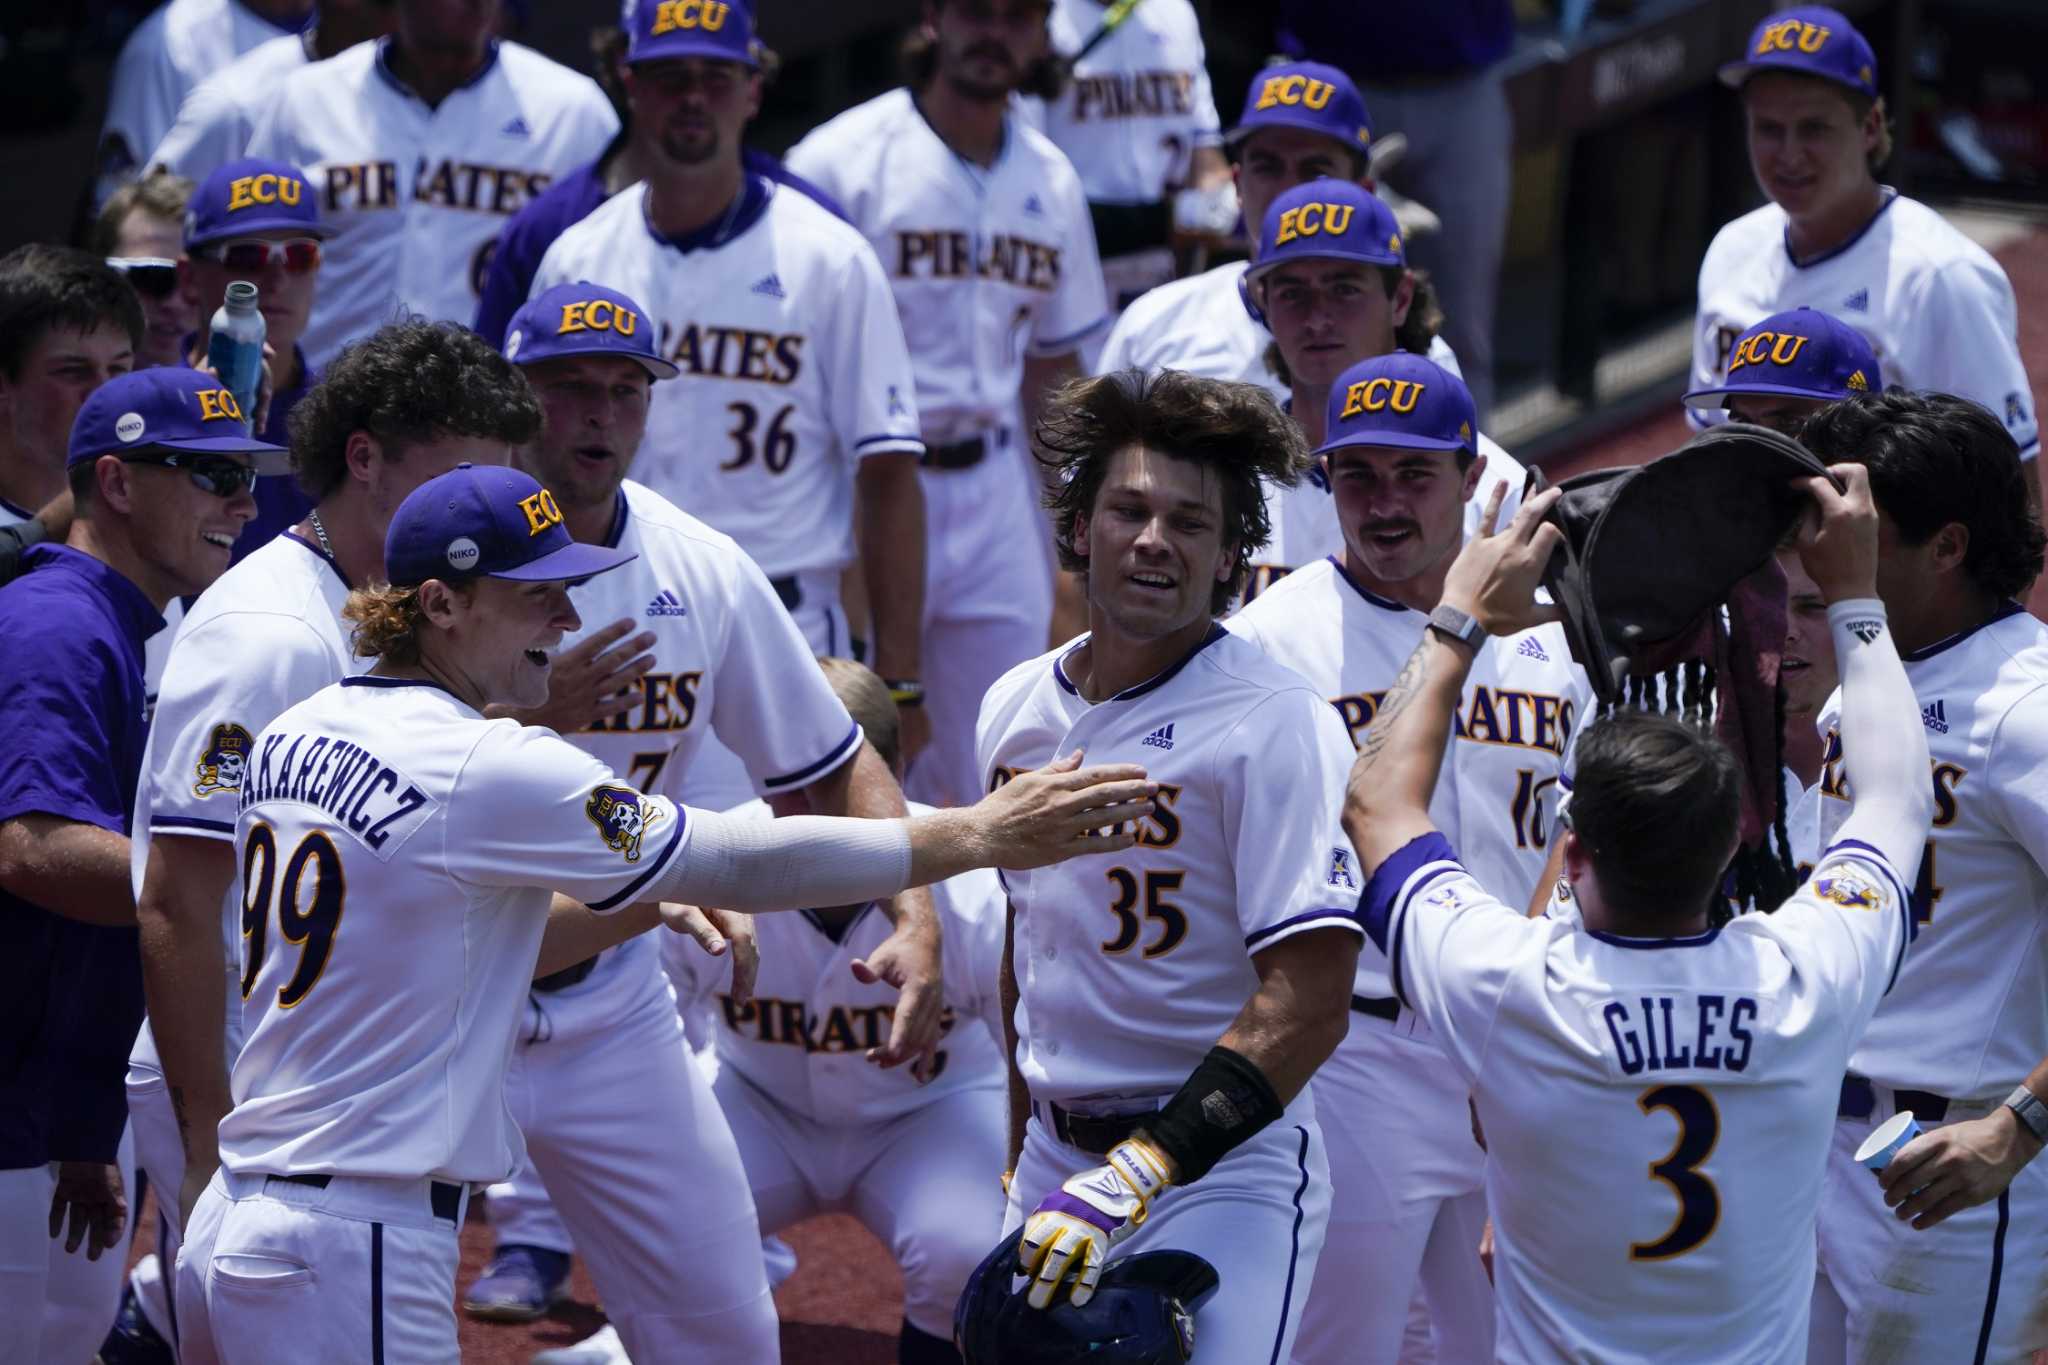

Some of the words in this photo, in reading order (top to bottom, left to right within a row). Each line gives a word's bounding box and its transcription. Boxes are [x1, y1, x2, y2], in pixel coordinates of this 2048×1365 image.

[650, 0, 729, 35] ECU
[1756, 19, 1829, 54] ECU
[1255, 75, 1336, 110] ECU
[227, 165, 302, 211] ECU
[1276, 203, 1355, 245] ECU
[557, 299, 636, 336] ECU
[660, 321, 804, 386] ATES
[1728, 331, 1808, 373] ECU
[195, 389, 246, 424] EC
[1339, 378, 1425, 419] ECU
[118, 421, 142, 434] NIKO
[719, 402, 797, 475] 36
[517, 489, 564, 536] EC
[449, 547, 477, 560] NIKO
[646, 607, 687, 617] adidas
[1517, 648, 1550, 662] adidas
[219, 737, 242, 749] ECU
[1142, 735, 1175, 751] adidas
[239, 733, 428, 850] AKAREWICZ
[241, 821, 347, 1009] 99
[1102, 866, 1190, 959] 35
[714, 993, 956, 1054] PIRAT
[1603, 995, 1758, 1076] GILES
[1628, 1083, 1722, 1263] 3
